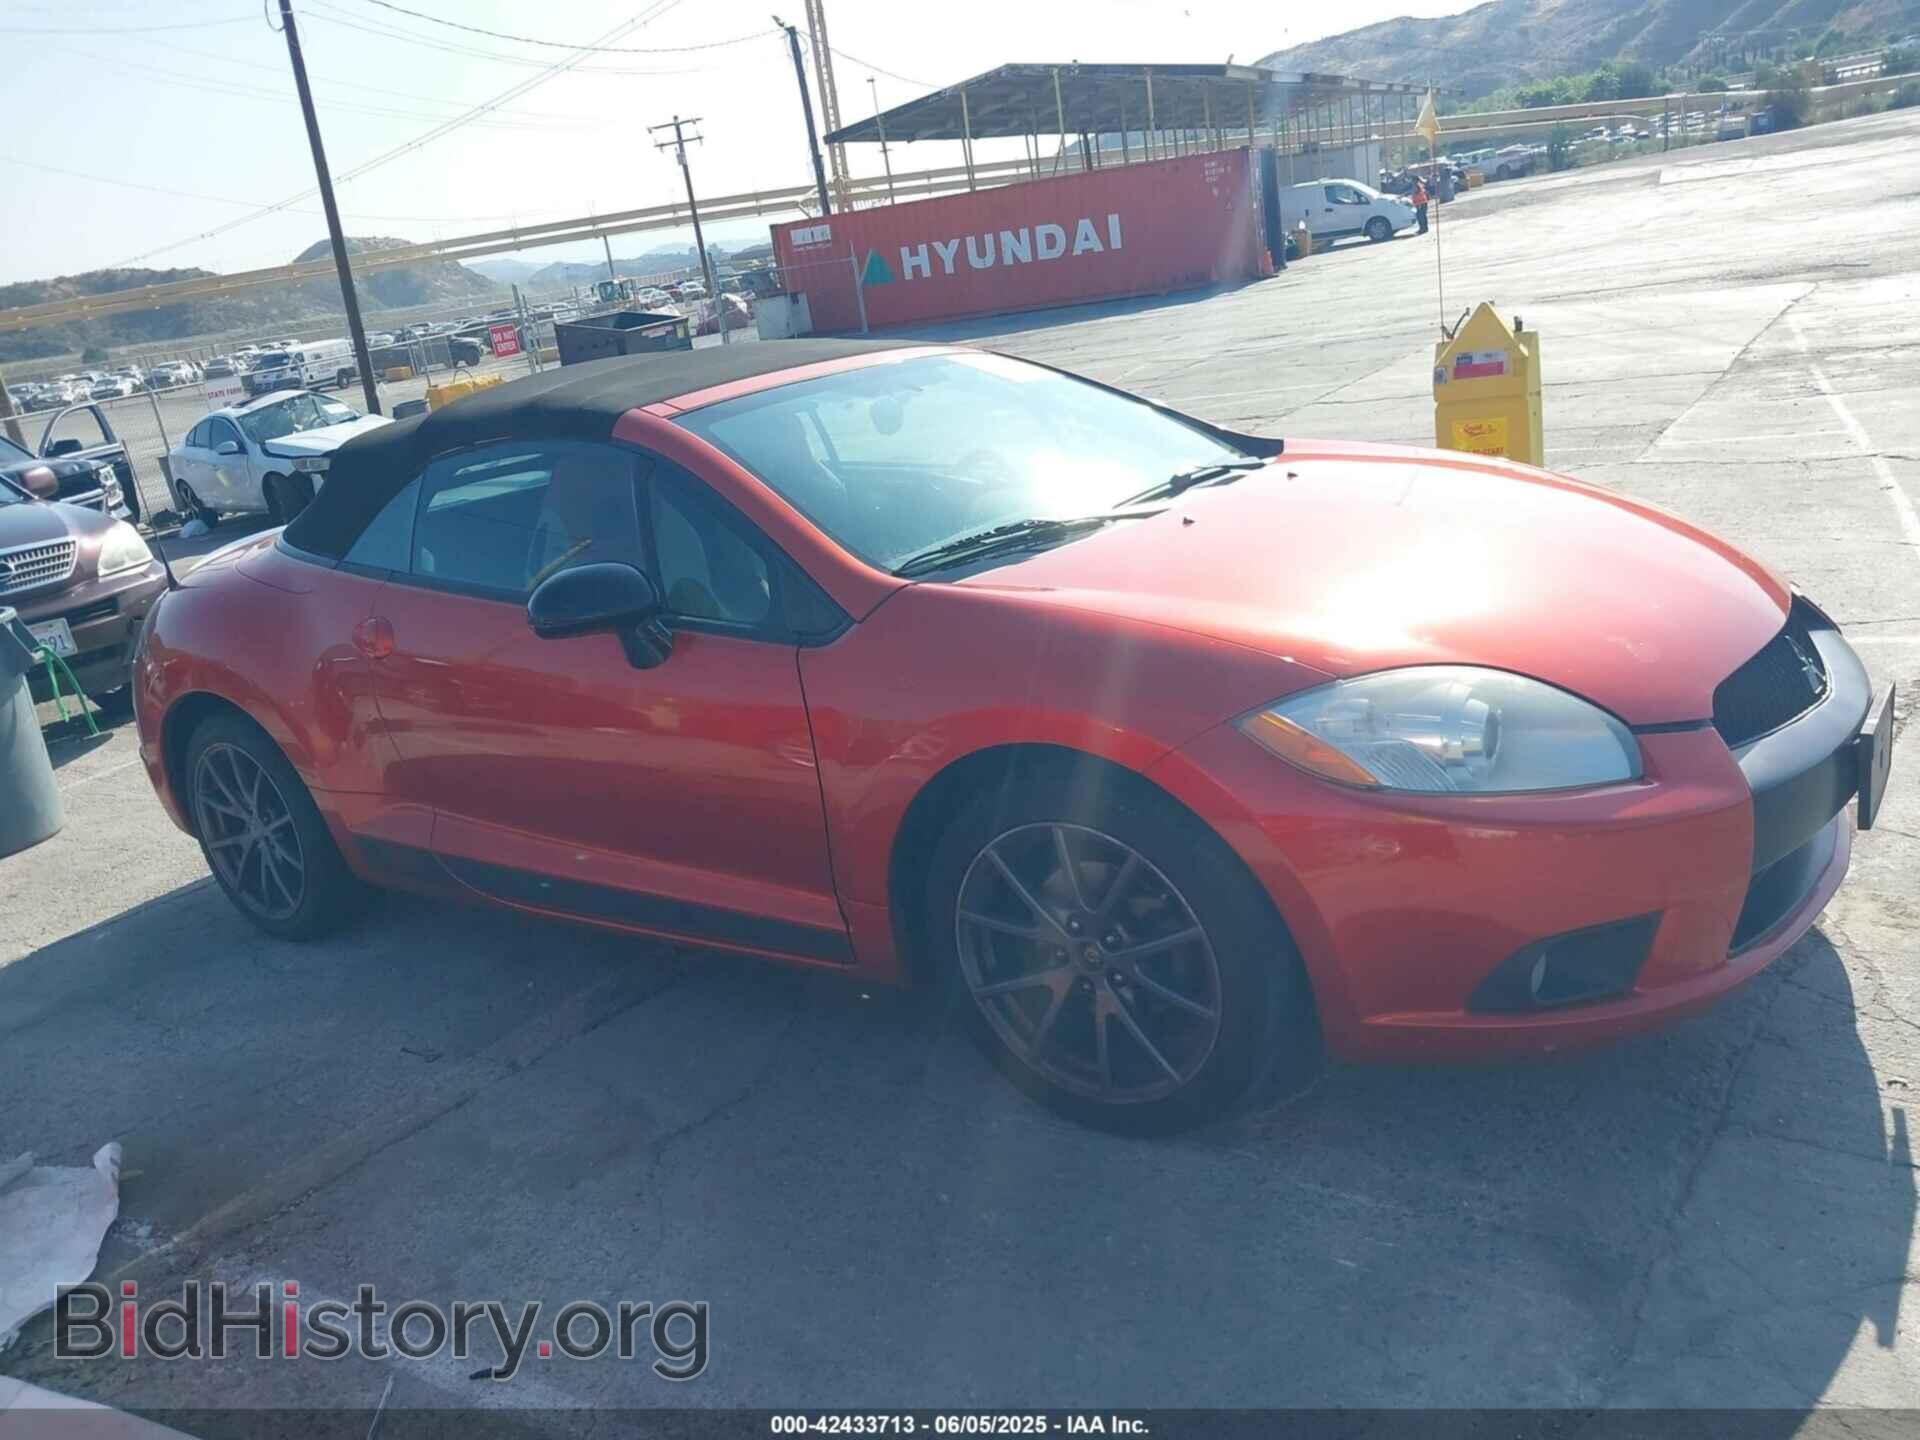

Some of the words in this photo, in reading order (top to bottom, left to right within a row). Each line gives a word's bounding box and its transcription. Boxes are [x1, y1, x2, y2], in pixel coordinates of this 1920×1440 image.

[901, 213, 1123, 281] HYUNDAI
[503, 331, 514, 341] NOT
[496, 341, 518, 352] ENTER
[207, 390, 225, 400] STATE
